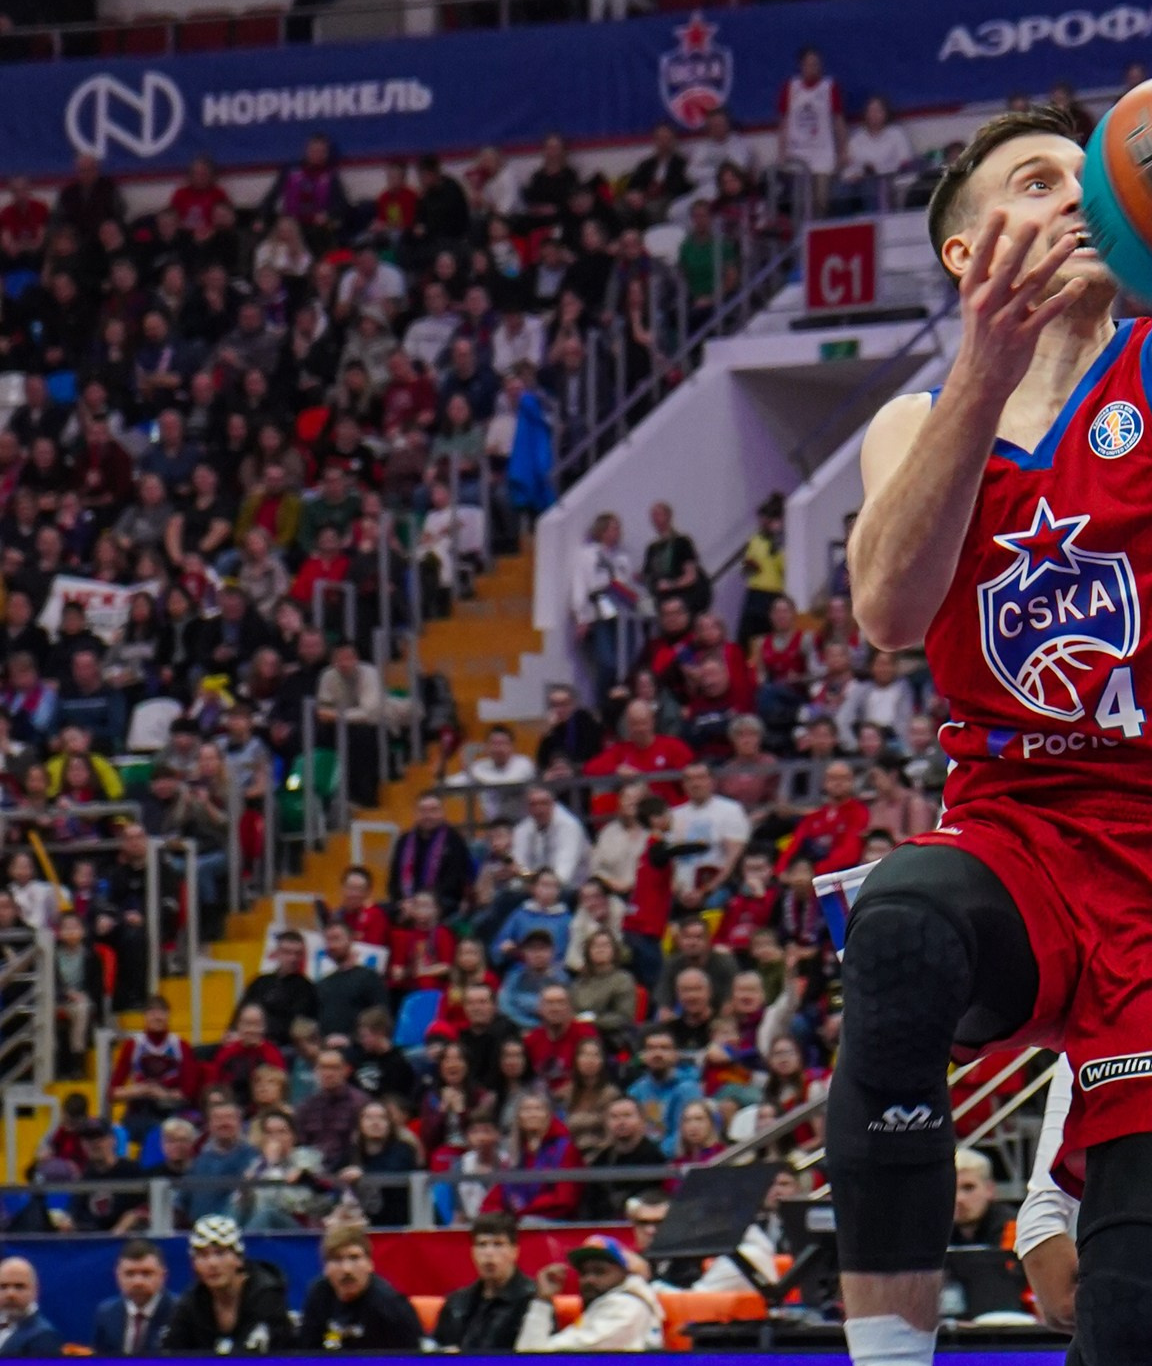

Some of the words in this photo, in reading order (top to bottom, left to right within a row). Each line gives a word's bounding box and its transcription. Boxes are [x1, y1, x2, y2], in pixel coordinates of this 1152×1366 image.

[203, 76, 433, 127] НОРНИКЕЛЬ
[999, 580, 1117, 638] CSKA
[1094, 664, 1147, 739] 4
